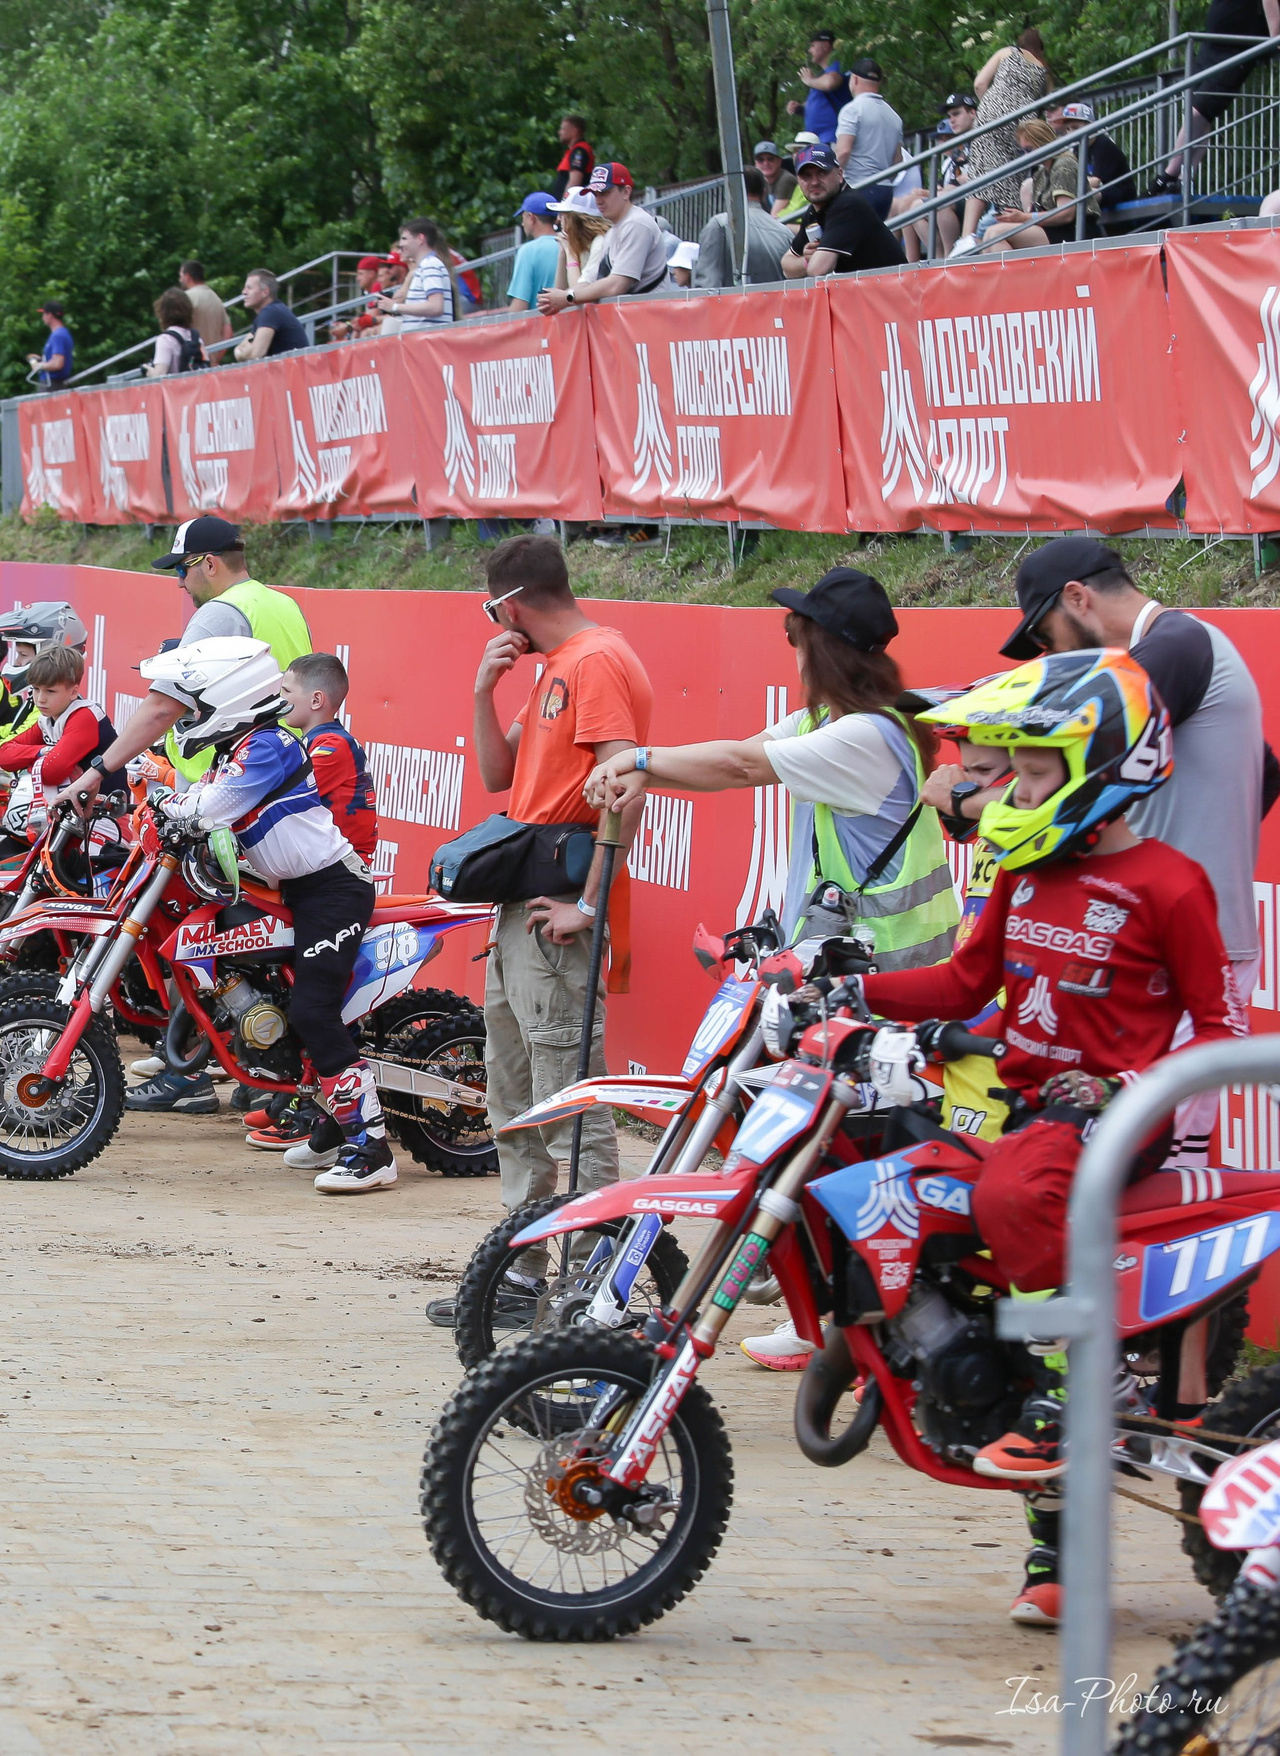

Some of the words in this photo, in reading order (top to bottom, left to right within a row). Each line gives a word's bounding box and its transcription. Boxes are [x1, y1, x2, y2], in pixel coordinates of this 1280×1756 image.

[670, 318, 792, 416] МОСКОВСКИЙ
[917, 284, 1102, 407] МОСКОВСКИЙ
[470, 338, 555, 427] МОСКОВСКИЙ
[671, 425, 723, 500] СПОРТ
[45, 902, 94, 912] KENDA
[194, 935, 274, 957] MXSCHOOL
[374, 930, 420, 971] 98
[1005, 914, 1115, 962] GASGAS
[632, 1198, 718, 1215] GASGAS
[721, 1242, 760, 1300] BUD
[1162, 1215, 1271, 1297] 777
